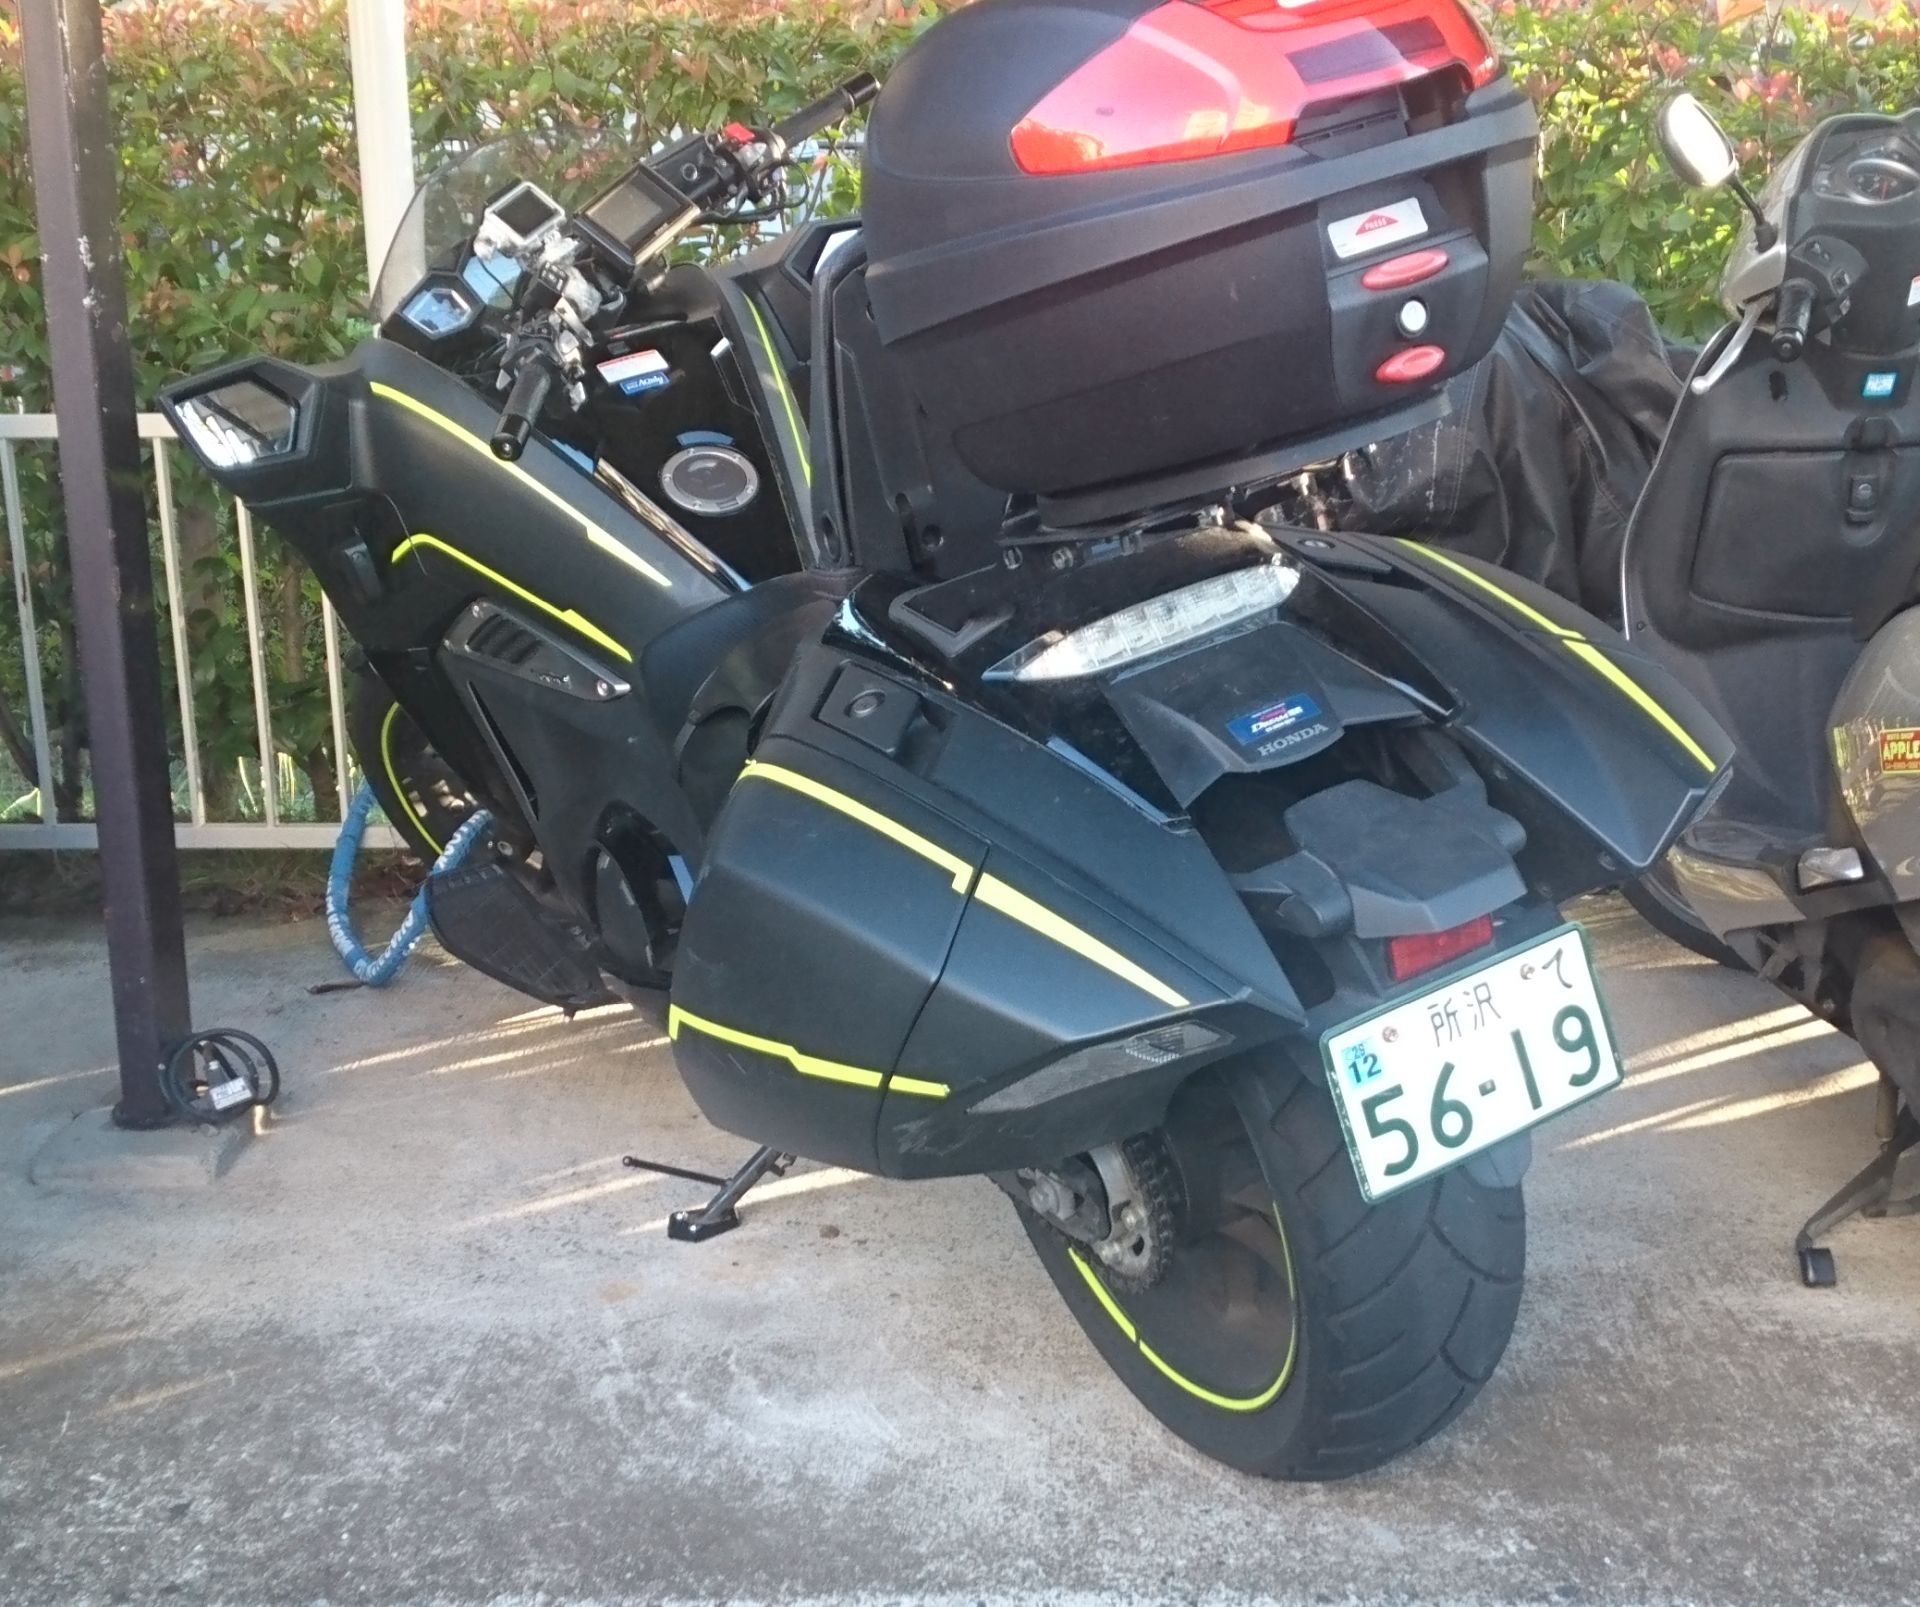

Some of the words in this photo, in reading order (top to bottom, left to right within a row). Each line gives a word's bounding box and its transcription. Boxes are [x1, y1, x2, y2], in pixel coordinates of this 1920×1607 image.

[1364, 217, 1387, 231] PRESS
[1257, 723, 1329, 757] HONDA
[1882, 740, 1920, 760] APPLE
[1427, 981, 1502, 1048] 所沢
[1541, 947, 1574, 989] て
[1348, 1053, 1382, 1084] 12
